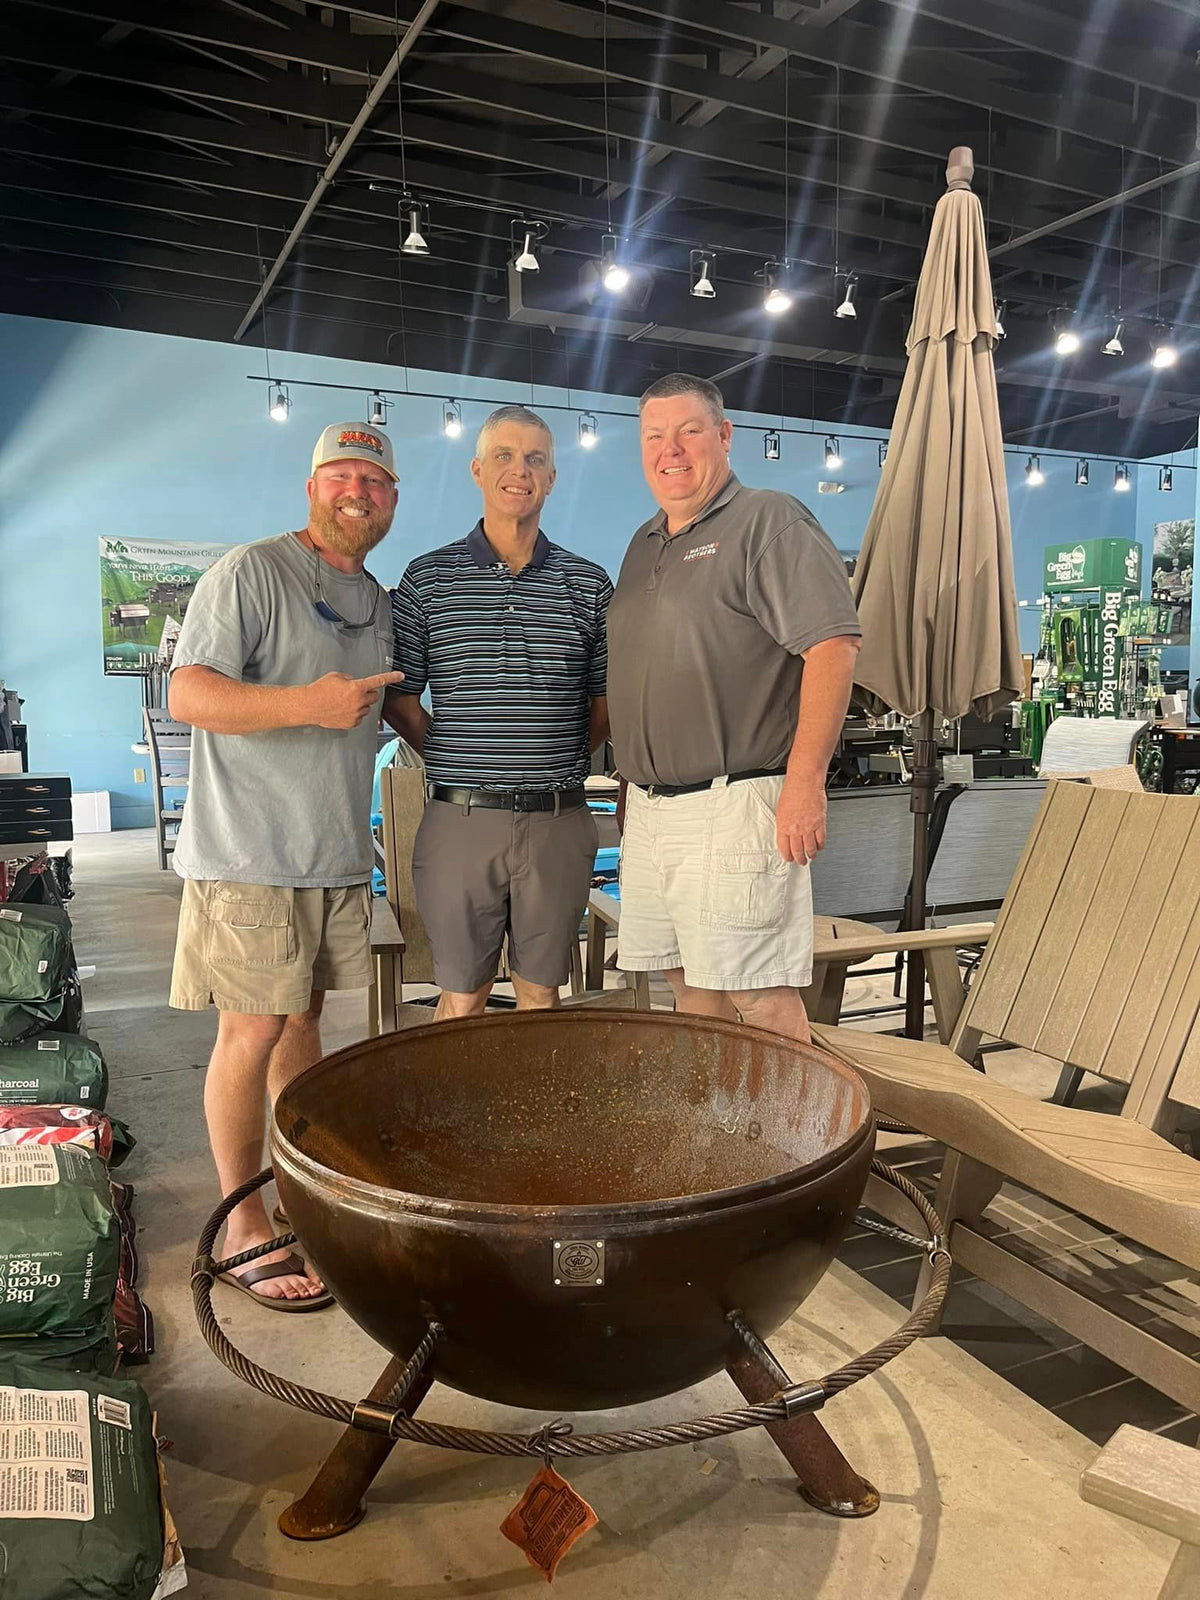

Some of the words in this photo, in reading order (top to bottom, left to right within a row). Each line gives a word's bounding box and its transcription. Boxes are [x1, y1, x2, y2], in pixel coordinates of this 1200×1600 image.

[130, 546, 156, 554] GREEN
[157, 548, 200, 557] MOUNTAIN
[1058, 552, 1072, 563] Big
[1047, 562, 1072, 573] Green
[129, 571, 153, 582] THIS
[155, 572, 191, 584] GOOD!
[1056, 570, 1072, 581] Egg
[1101, 592, 1121, 621] Big
[1103, 622, 1120, 678] Green
[1098, 680, 1117, 713] Egg
[86, 1251, 94, 1268] USA
[9, 1259, 41, 1276] Egg
[85, 1268, 92, 1277] IN
[8, 1274, 61, 1288] Green
[6, 1288, 34, 1303] Big
[83, 1277, 91, 1300] MADE
